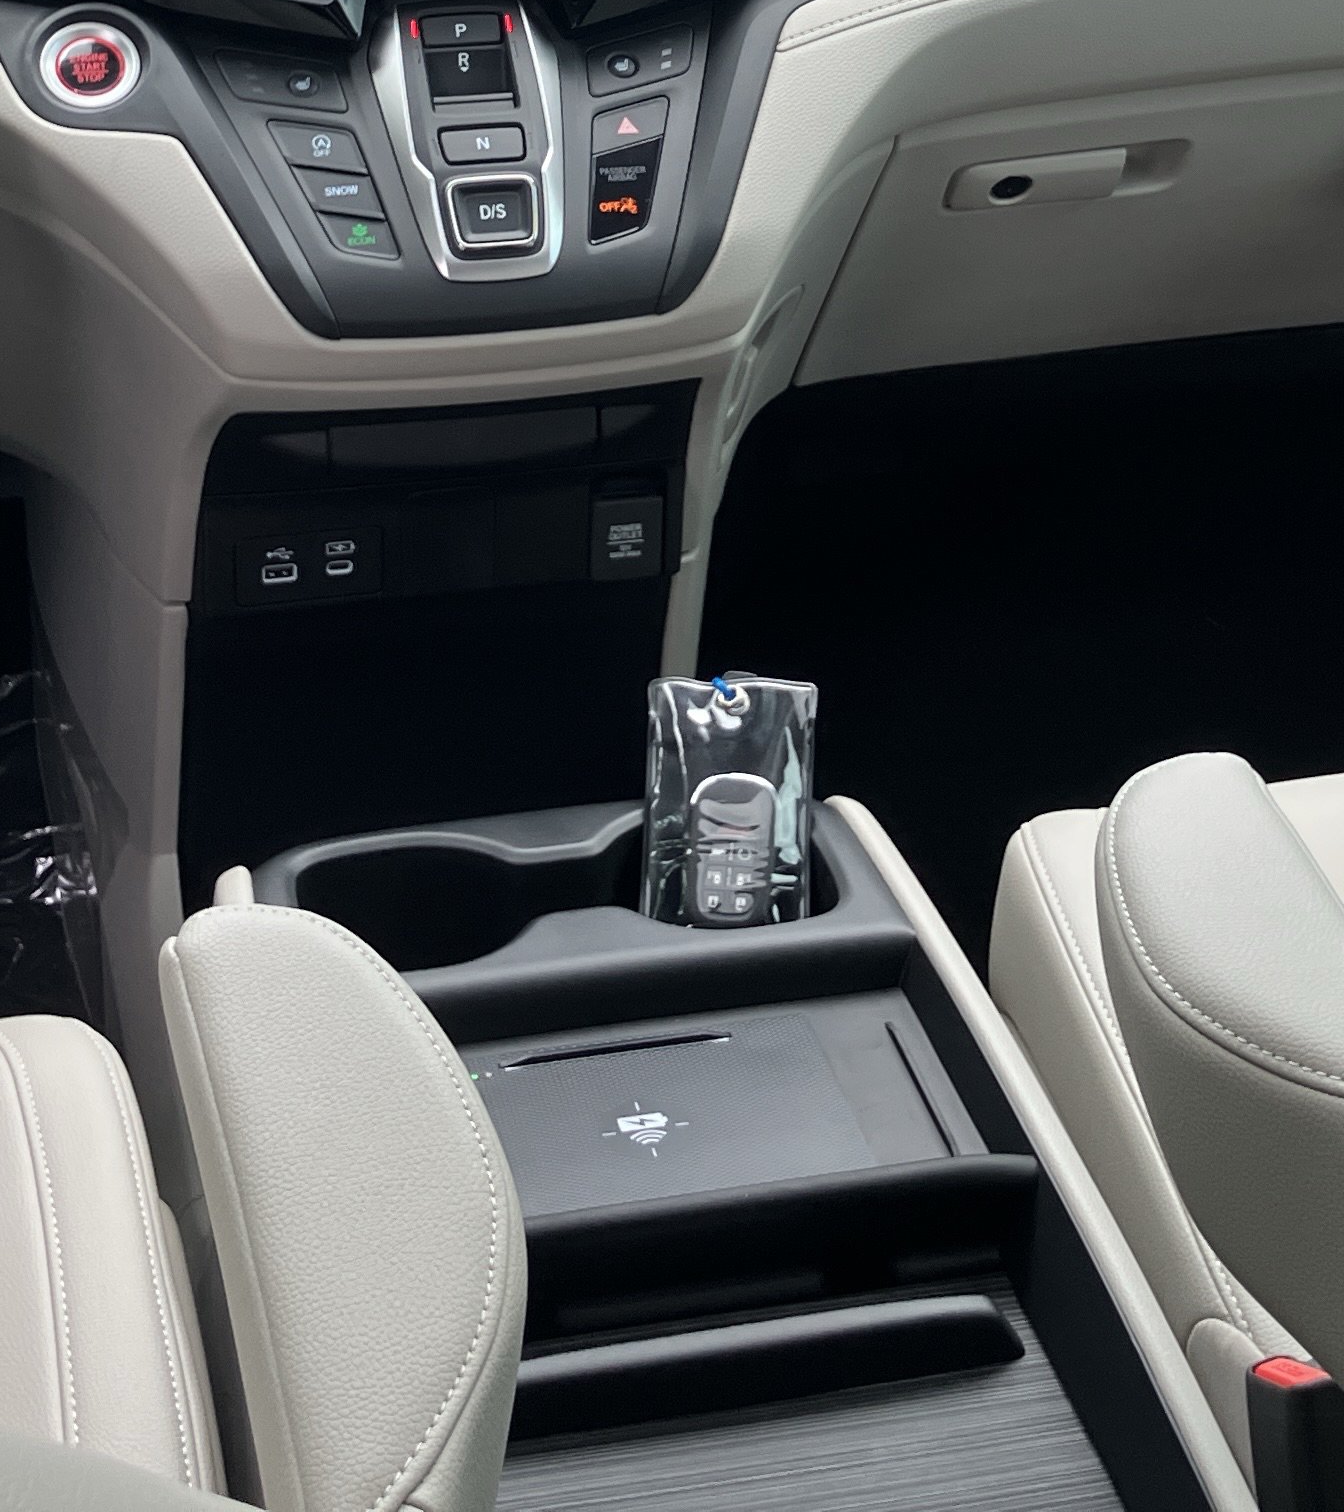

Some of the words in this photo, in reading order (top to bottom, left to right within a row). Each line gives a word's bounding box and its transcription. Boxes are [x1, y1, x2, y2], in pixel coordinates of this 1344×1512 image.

[454, 22, 467, 39] P
[457, 51, 470, 67] R
[475, 136, 491, 151] N
[312, 148, 331, 158] OFF
[323, 184, 359, 198] SNOW
[478, 203, 507, 220] D/S
[598, 201, 621, 213] OFF
[346, 235, 377, 247] ECON
